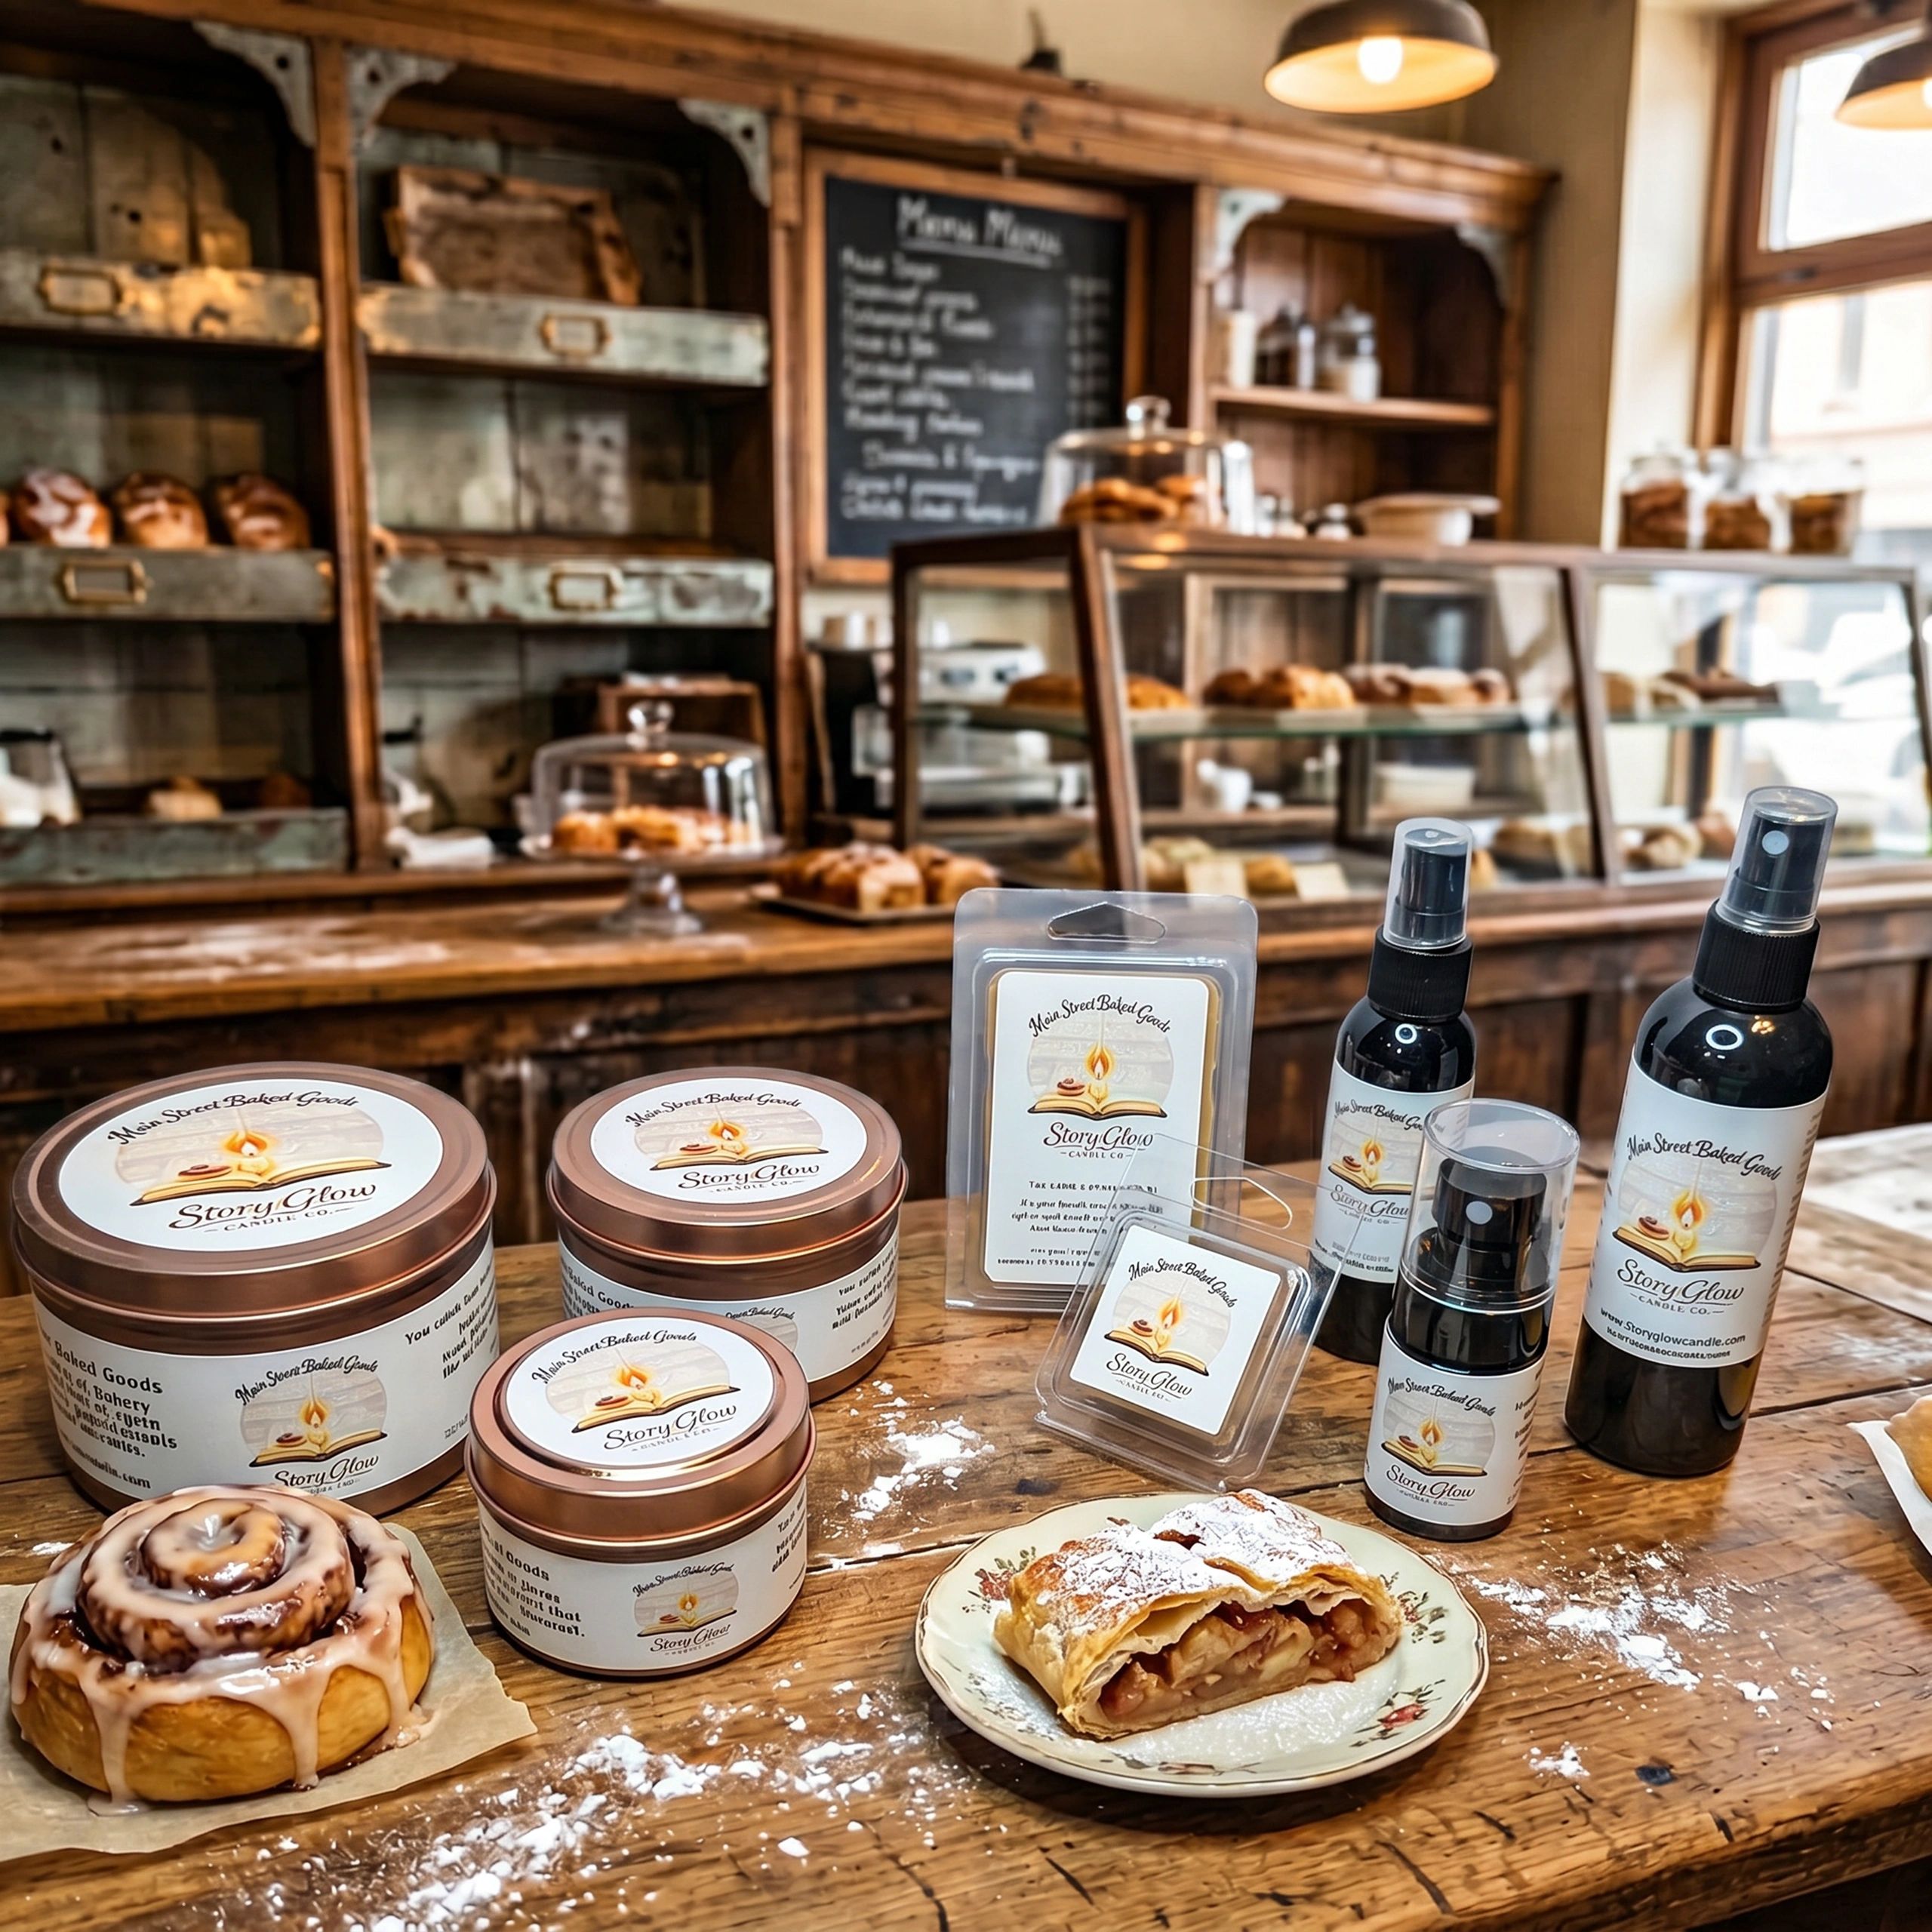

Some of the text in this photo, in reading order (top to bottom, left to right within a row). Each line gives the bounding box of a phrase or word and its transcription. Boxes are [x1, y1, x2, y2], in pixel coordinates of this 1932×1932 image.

[704, 1093, 754, 1104] Baked
[107, 1119, 162, 1145] Main
[223, 1093, 293, 1108] Baked
[1044, 1121, 1100, 1151] Story
[1627, 1134, 1651, 1161] Main
[1653, 1132, 1693, 1154] Street
[1692, 1140, 1747, 1164] Baked
[678, 1164, 820, 1189] Story Glow
[168, 1184, 376, 1229] Story Glow
[1617, 1259, 1744, 1304] Story Glow
[405, 1325, 430, 1345] You
[54, 1340, 97, 1377] Baked
[103, 1367, 163, 1394] Goods
[1106, 1353, 1149, 1384] Story
[1150, 1371, 1192, 1395] Glow
[603, 1404, 737, 1450] Story Glow
[275, 1469, 326, 1487] Story
[329, 1456, 379, 1484] Glow
[1429, 1481, 1475, 1499] Glow
[549, 1605, 581, 1623] that
